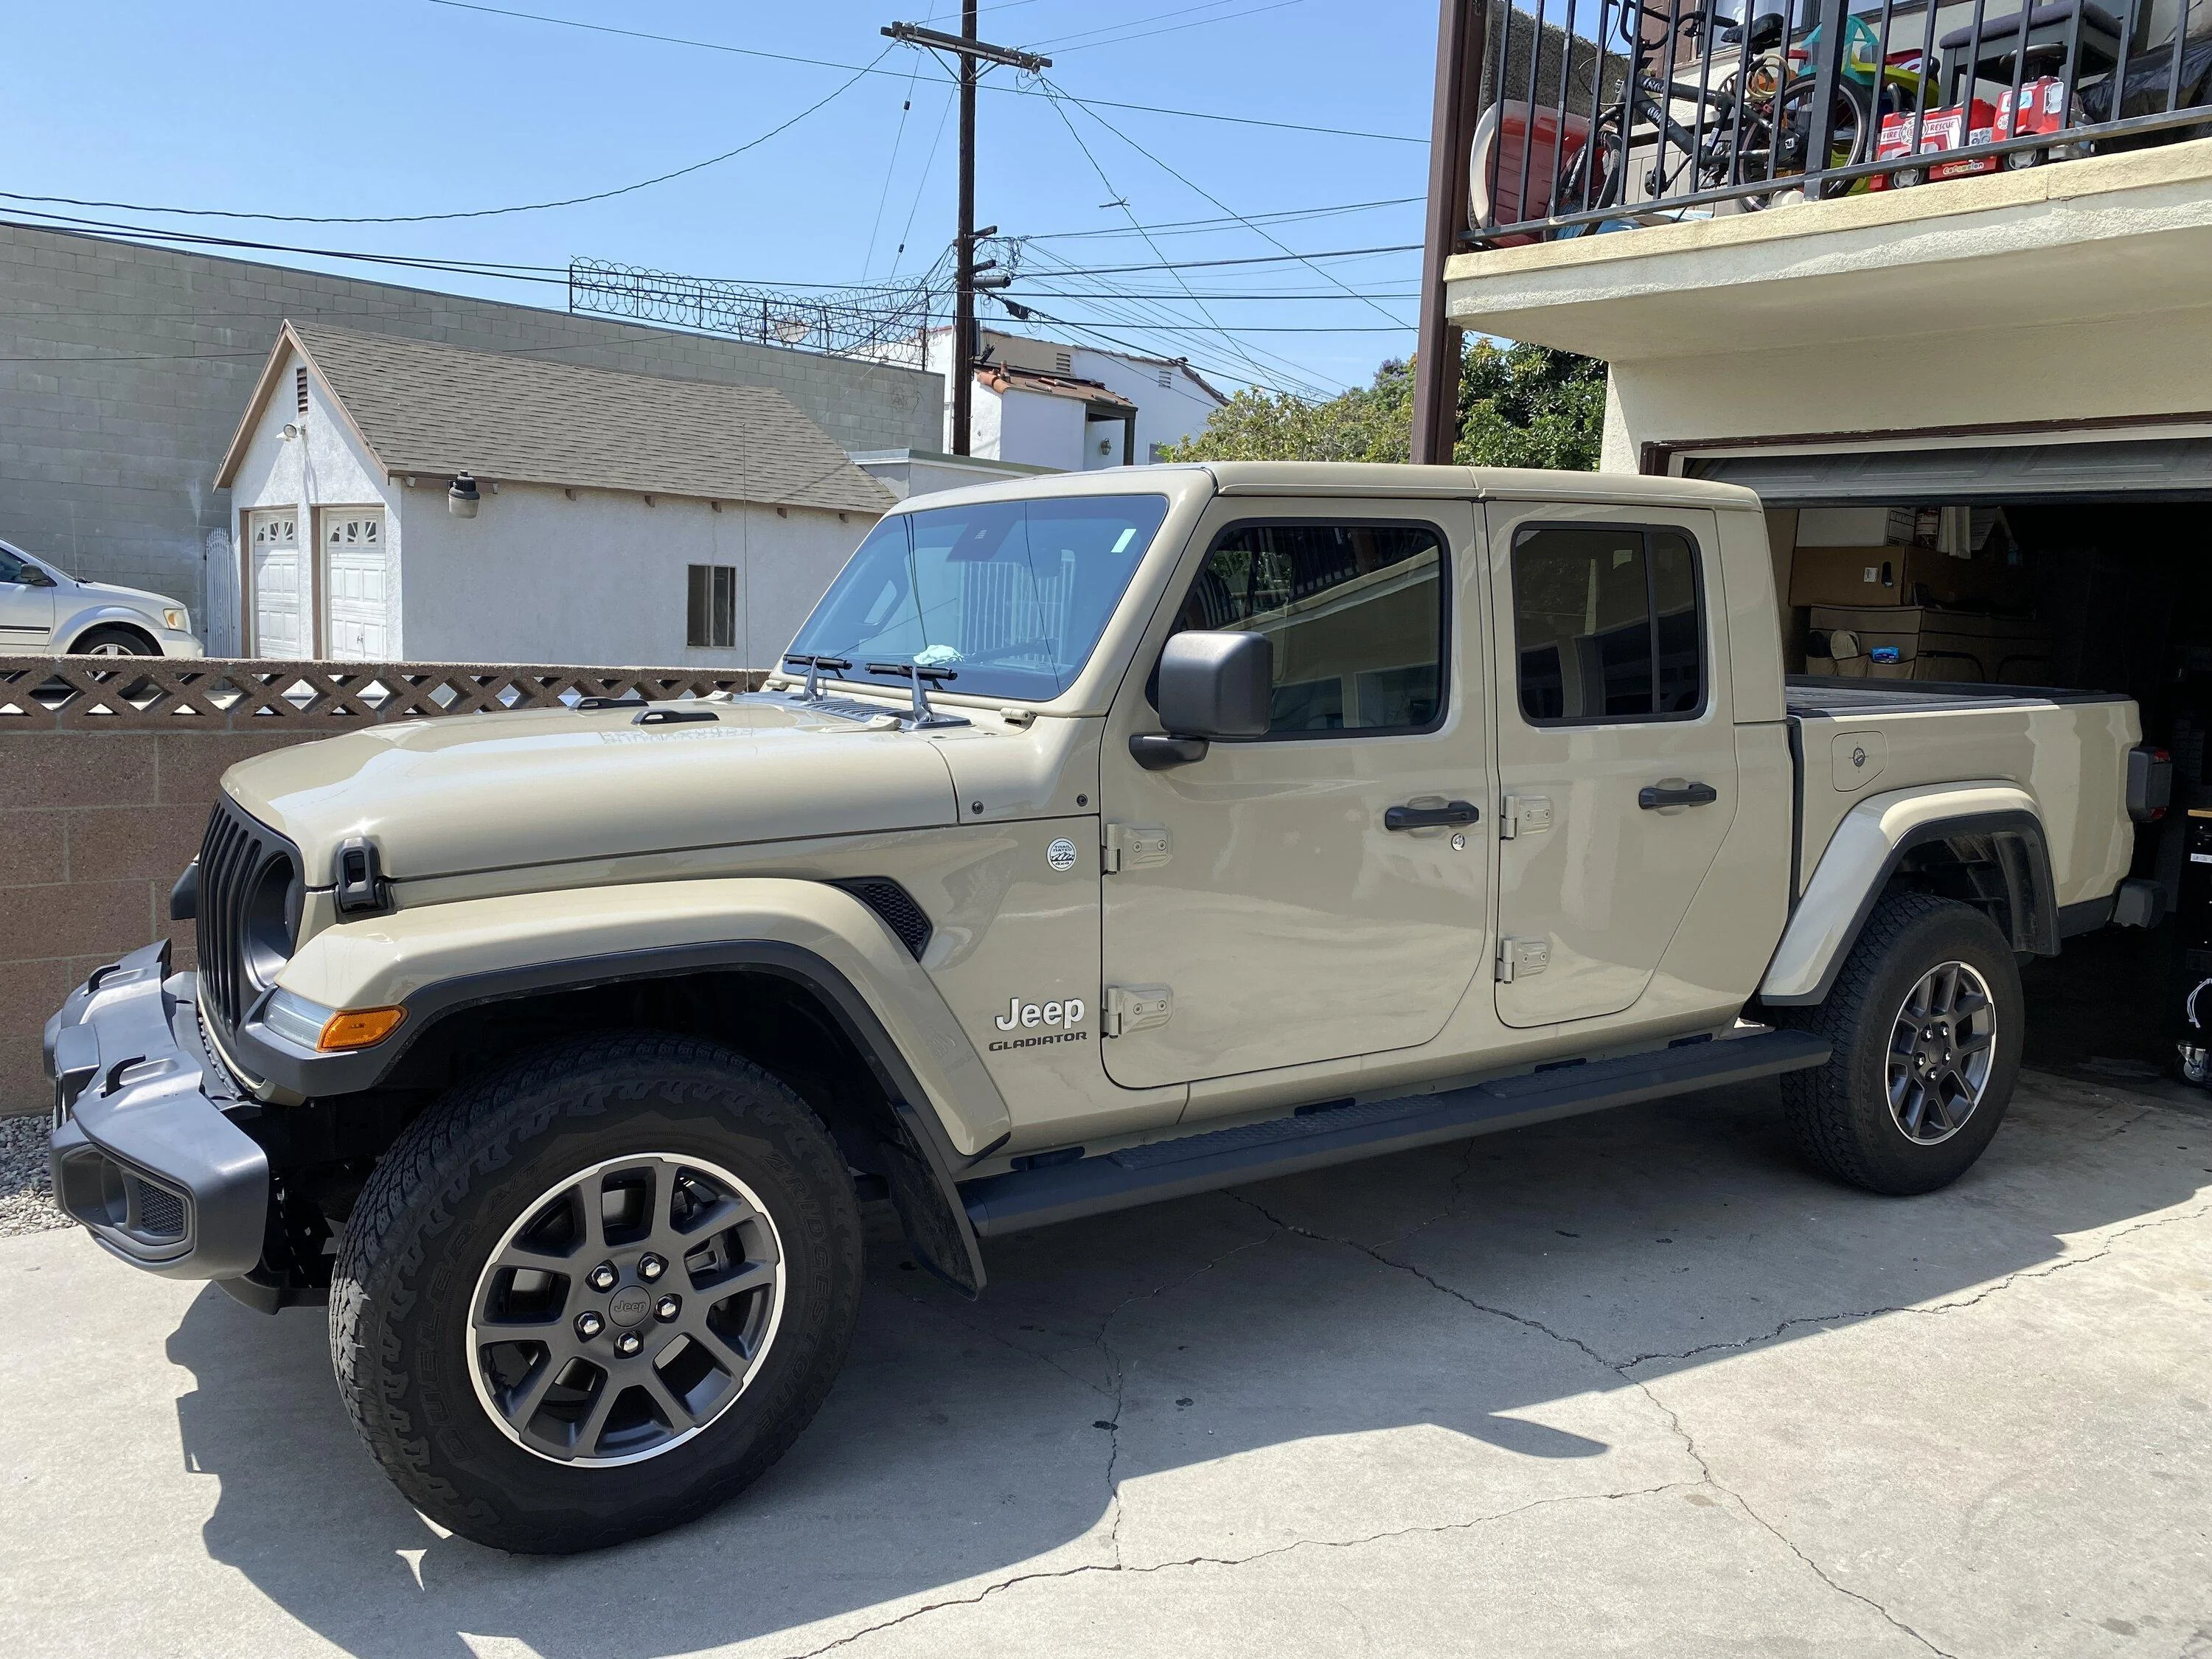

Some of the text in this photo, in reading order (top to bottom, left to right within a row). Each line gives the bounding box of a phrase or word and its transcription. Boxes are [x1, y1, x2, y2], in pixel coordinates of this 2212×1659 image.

[1930, 121, 1955, 131] RESCUE
[995, 997, 1085, 1031] Jeep
[989, 1032, 1088, 1051] GLADIATOR
[757, 1152, 833, 1436] BRIDGESTONE
[614, 1300, 647, 1313] Jeep
